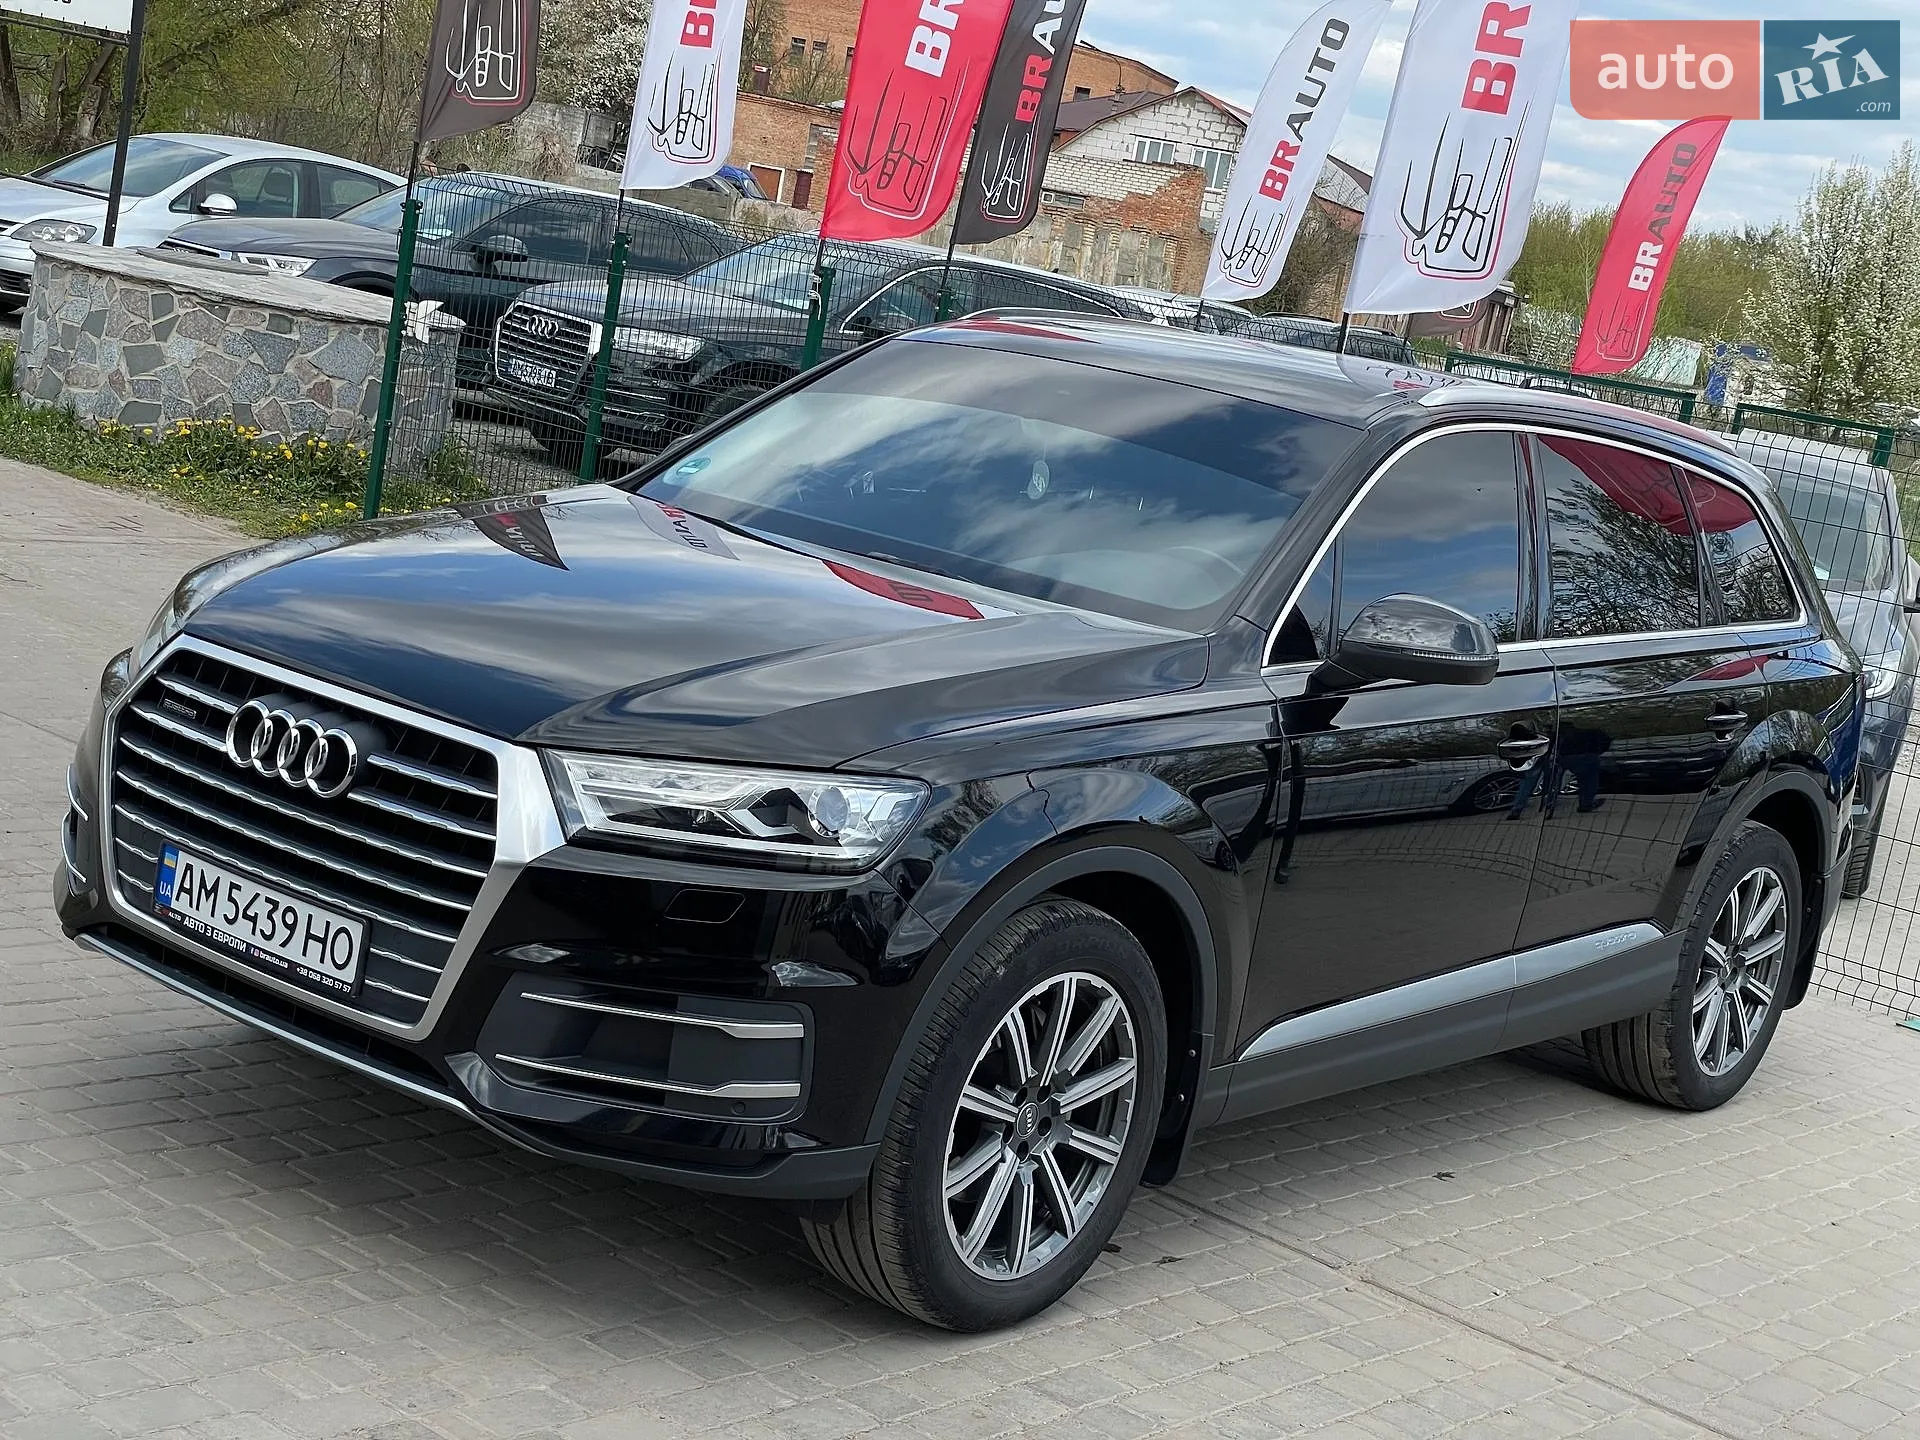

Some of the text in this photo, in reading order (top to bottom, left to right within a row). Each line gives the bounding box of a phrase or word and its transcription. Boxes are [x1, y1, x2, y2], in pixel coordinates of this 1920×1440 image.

[680, 0, 718, 48] B
[1461, 1, 1531, 115] BR
[1258, 18, 1350, 202] BRAUTO
[1628, 143, 1697, 291] BRAUTO
[159, 881, 172, 898] UA
[175, 862, 354, 971] AM 5439 HO
[183, 917, 205, 933] АВТО
